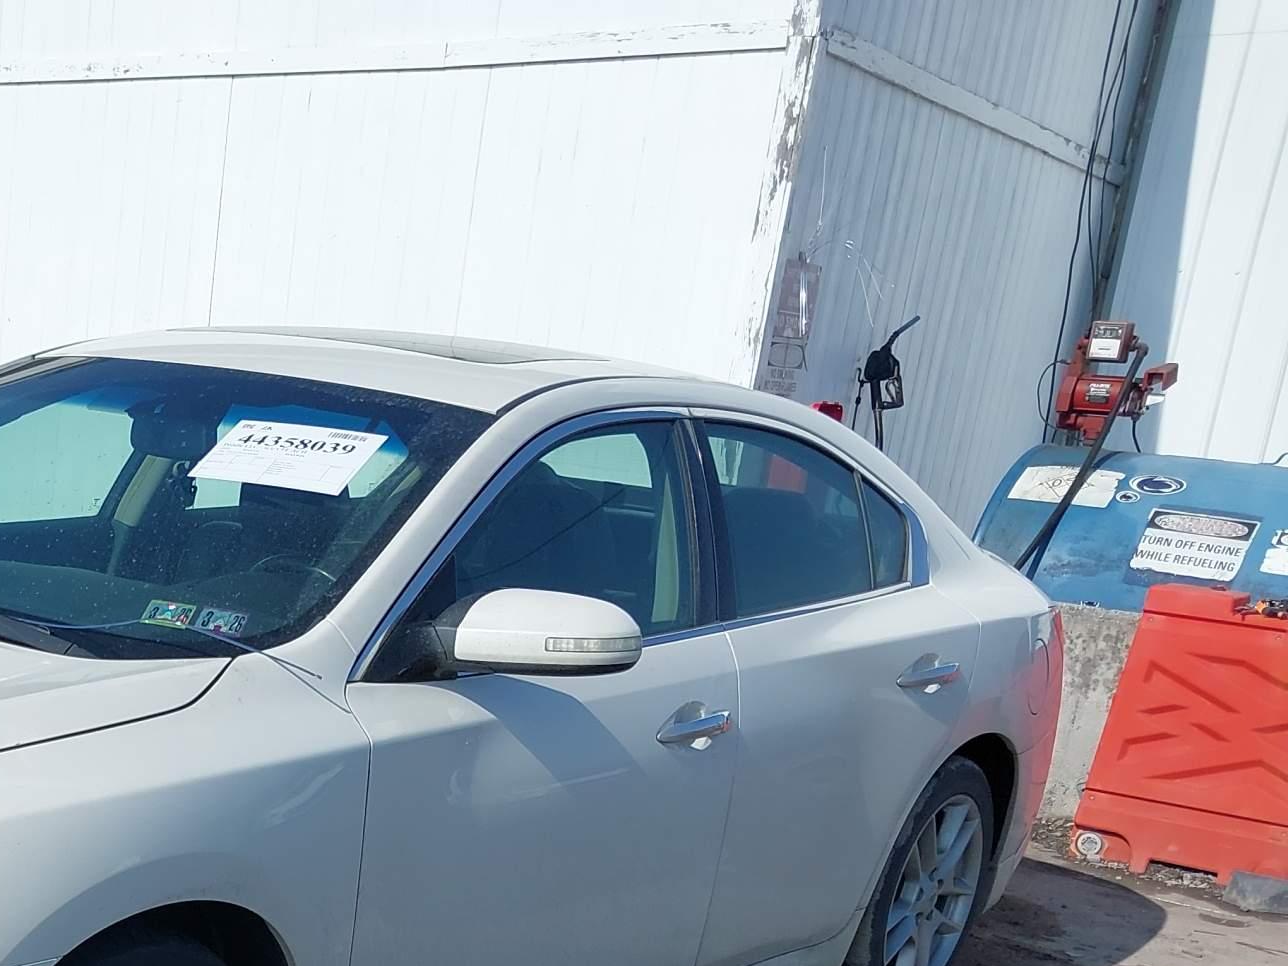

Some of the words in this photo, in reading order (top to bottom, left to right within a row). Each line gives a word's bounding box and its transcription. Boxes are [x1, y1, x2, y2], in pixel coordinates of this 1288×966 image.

[238, 433, 357, 456] 44358039
[1142, 535, 1172, 548] TURN
[1174, 539, 1197, 550] OFF
[1196, 542, 1243, 557] ENGINE
[1135, 550, 1171, 563] WHILE
[1172, 554, 1237, 572] REFUELING
[149, 606, 160, 620] 3
[201, 611, 214, 627] 3
[228, 615, 245, 633] 26
